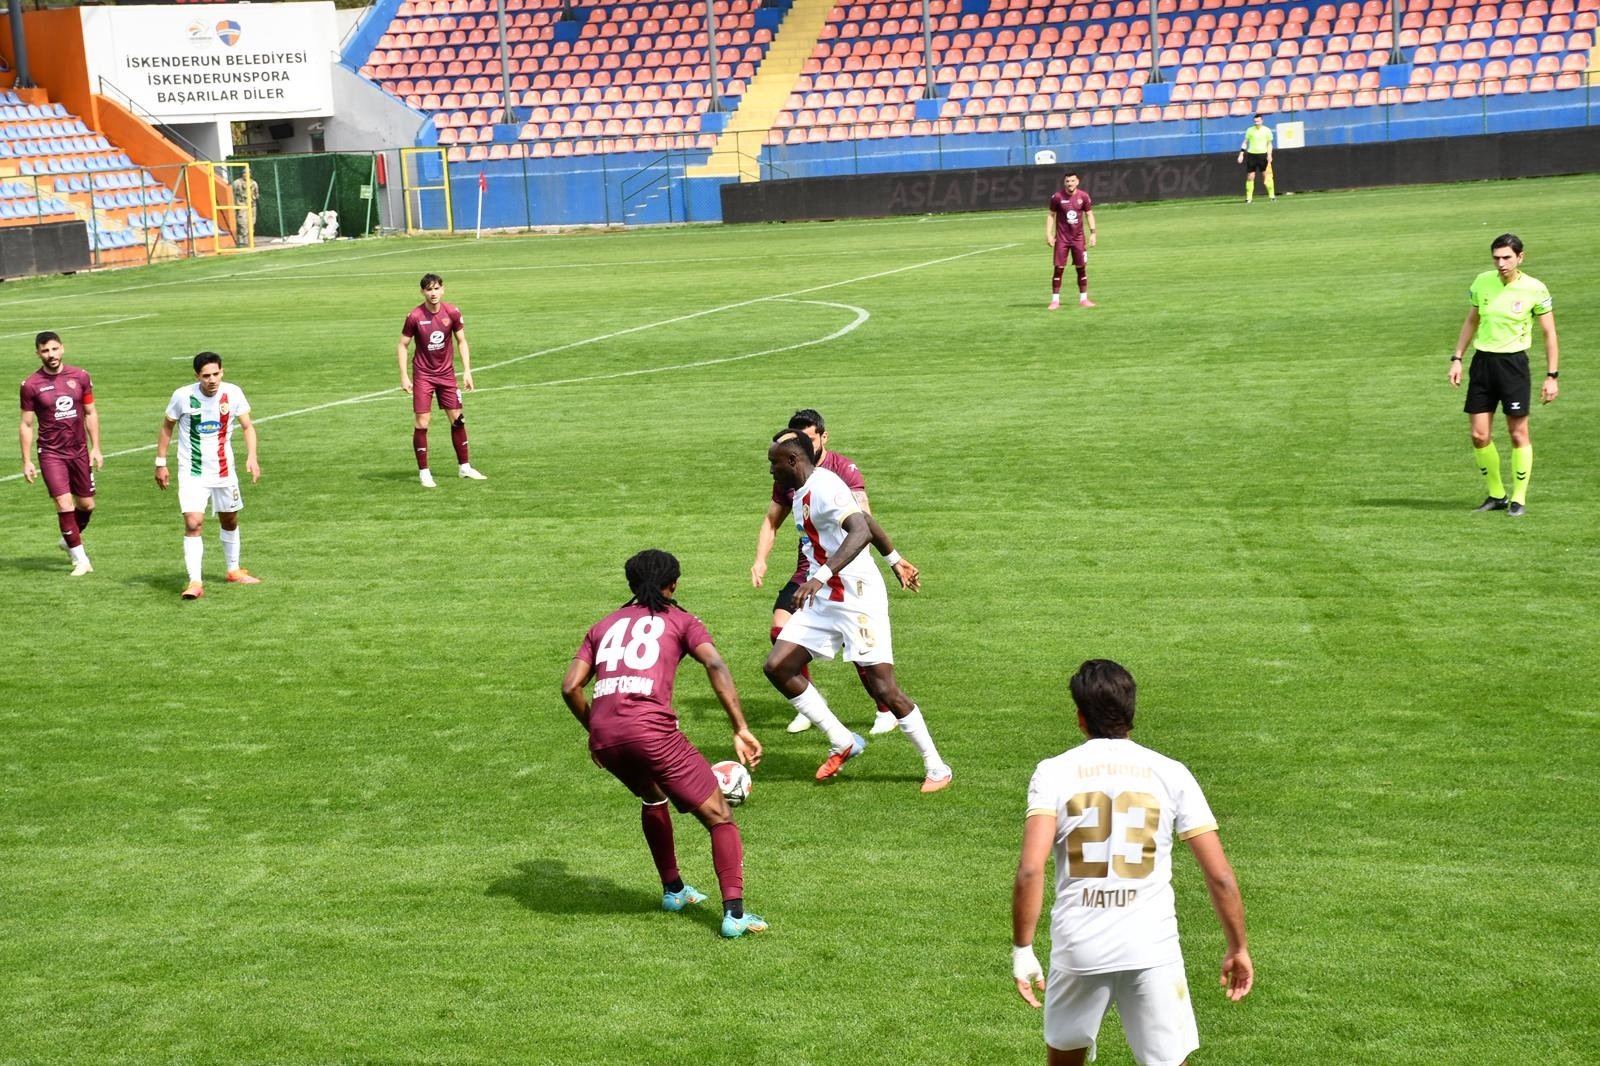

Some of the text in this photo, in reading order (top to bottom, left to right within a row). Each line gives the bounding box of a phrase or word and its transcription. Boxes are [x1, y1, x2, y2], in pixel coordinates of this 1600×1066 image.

[126, 51, 307, 68] İSKENDERUN BELEDİYESİ
[148, 71, 290, 86] İSKENDERUNSPORA
[157, 87, 285, 105] BAŞARILAR DİLER
[888, 177, 962, 208] ASLA
[595, 616, 665, 672] 48
[1065, 790, 1161, 880] 23
